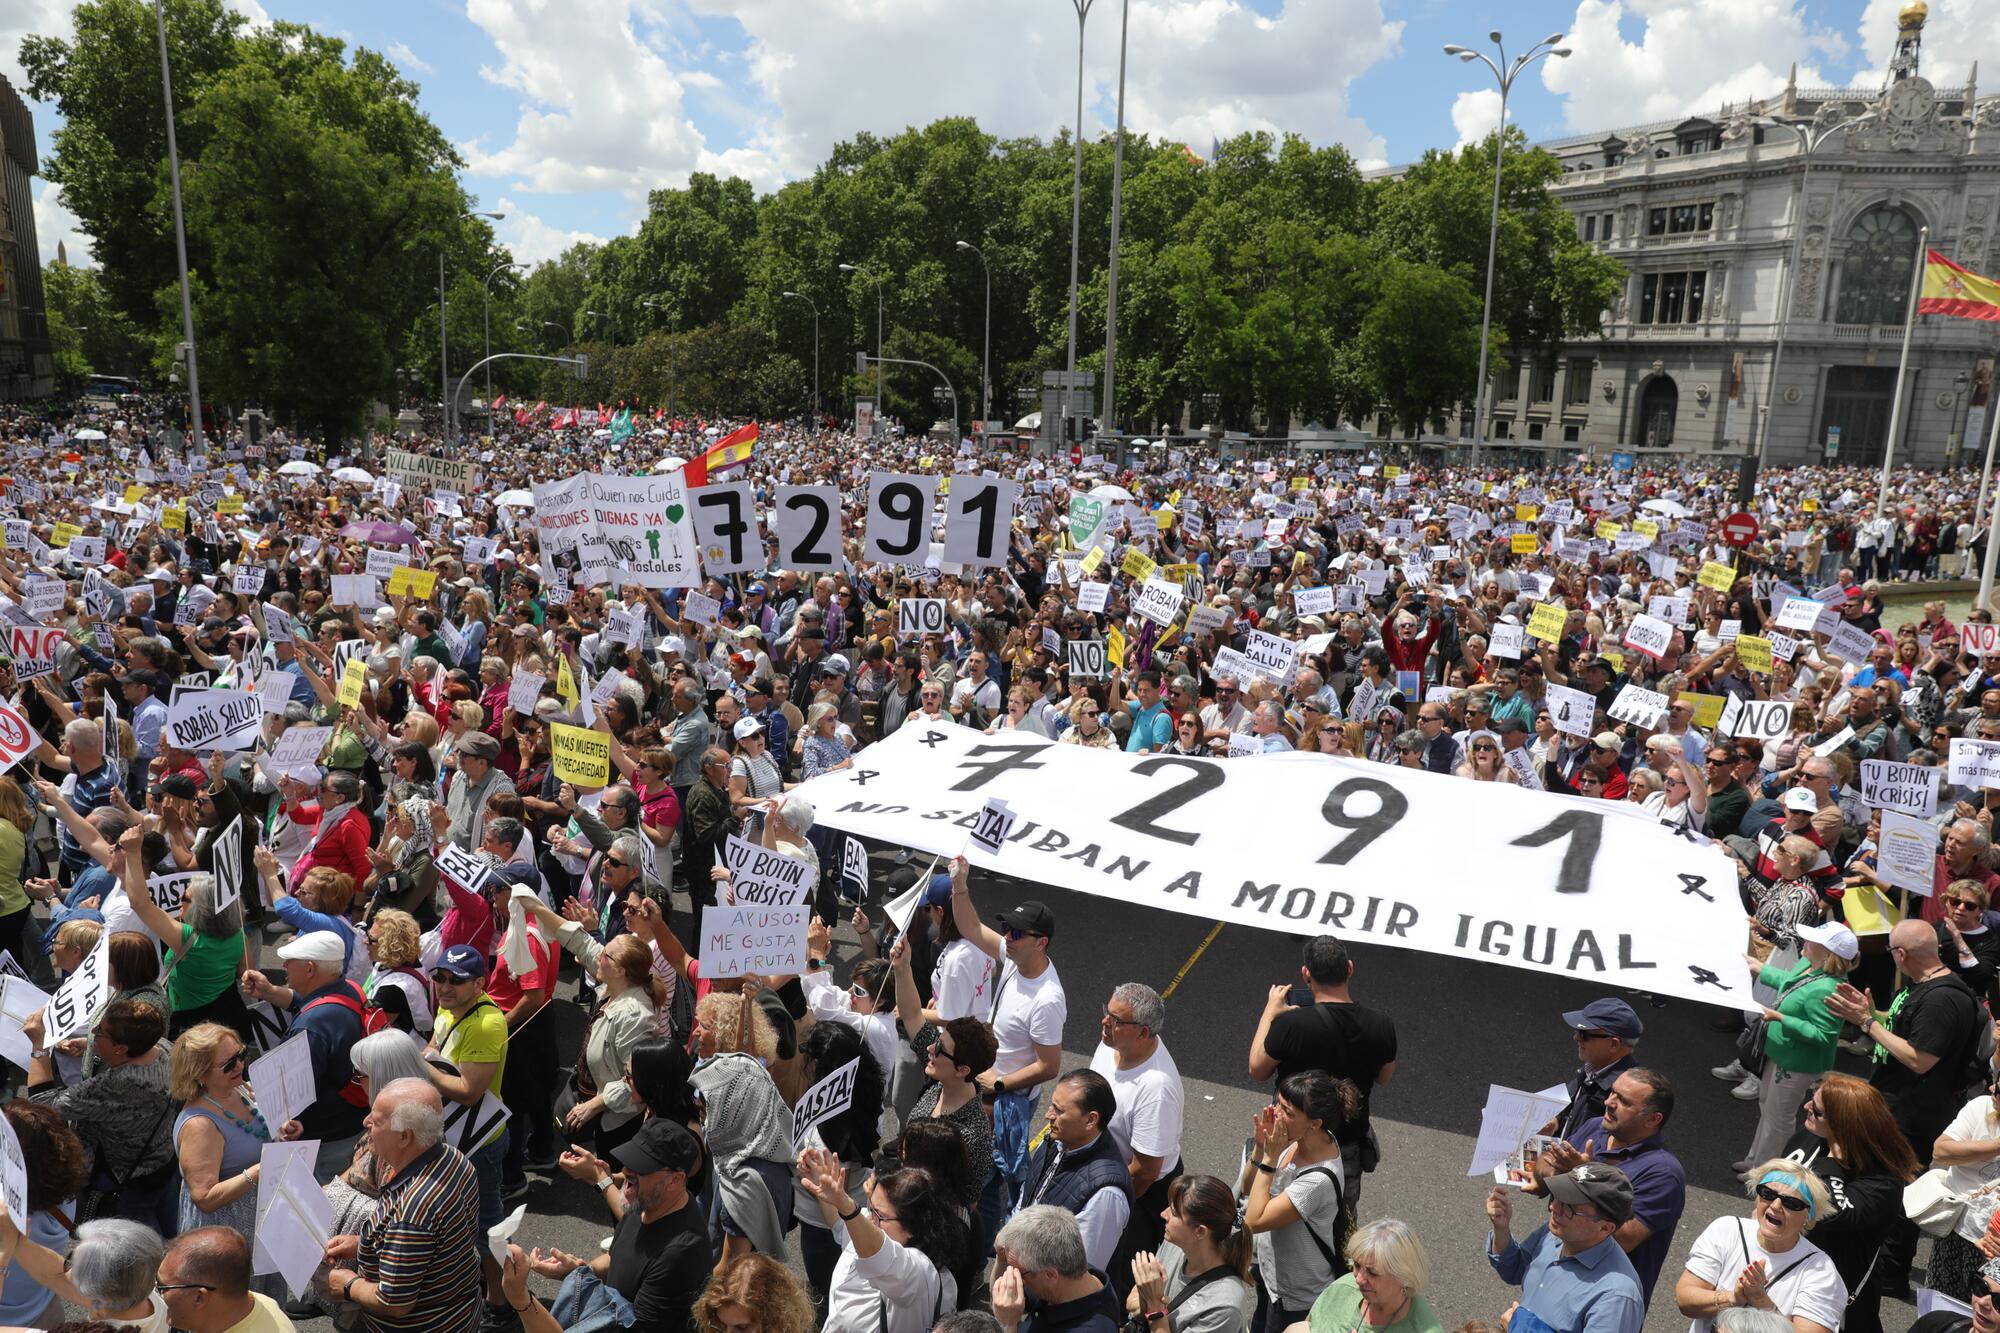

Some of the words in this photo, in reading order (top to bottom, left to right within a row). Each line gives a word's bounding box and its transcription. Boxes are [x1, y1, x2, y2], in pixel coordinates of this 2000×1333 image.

[389, 453, 469, 480] VILLAVERDE
[592, 483, 626, 504] Quien
[628, 490, 645, 503] nos
[648, 481, 681, 502] Cuida
[596, 509, 639, 525] DIGNAS
[698, 490, 748, 564] 7
[785, 494, 832, 564] 2
[876, 482, 924, 555] 9
[962, 485, 999, 558] 1
[608, 538, 635, 562] NO
[1143, 585, 1181, 612] ROBAN
[901, 602, 943, 630] NO
[1248, 632, 1277, 650] ¡Por
[1280, 642, 1292, 656] la
[1962, 624, 1996, 651] NO
[1070, 643, 1101, 674] NO
[1245, 648, 1290, 671] SALUD!
[1632, 689, 1668, 709] SANIDAD
[219, 694, 262, 732] SALUD!
[1737, 702, 1789, 737] NO
[560, 734, 575, 753] MÁS
[576, 737, 608, 760] MUERTES
[1958, 743, 1973, 756] Sin
[1863, 763, 1881, 780] TU
[1957, 762, 1977, 776] más
[1879, 786, 1929, 812] CRISIS!
[949, 743, 1056, 792] 7
[1111, 758, 1226, 847] 2
[1317, 777, 1408, 865] 9
[1510, 808, 1604, 896] 1
[729, 841, 751, 867] TU
[840, 799, 914, 816] NO
[1169, 870, 1203, 899] A
[1230, 880, 1419, 941] MORIR
[1454, 914, 1658, 971] IGUAL
[732, 910, 801, 929] AYUSO:
[711, 933, 733, 951] ME
[742, 933, 796, 950] GUSTA
[717, 959, 738, 975] LA
[744, 952, 796, 972] FRUTA
[792, 1063, 859, 1134] BASTA!
